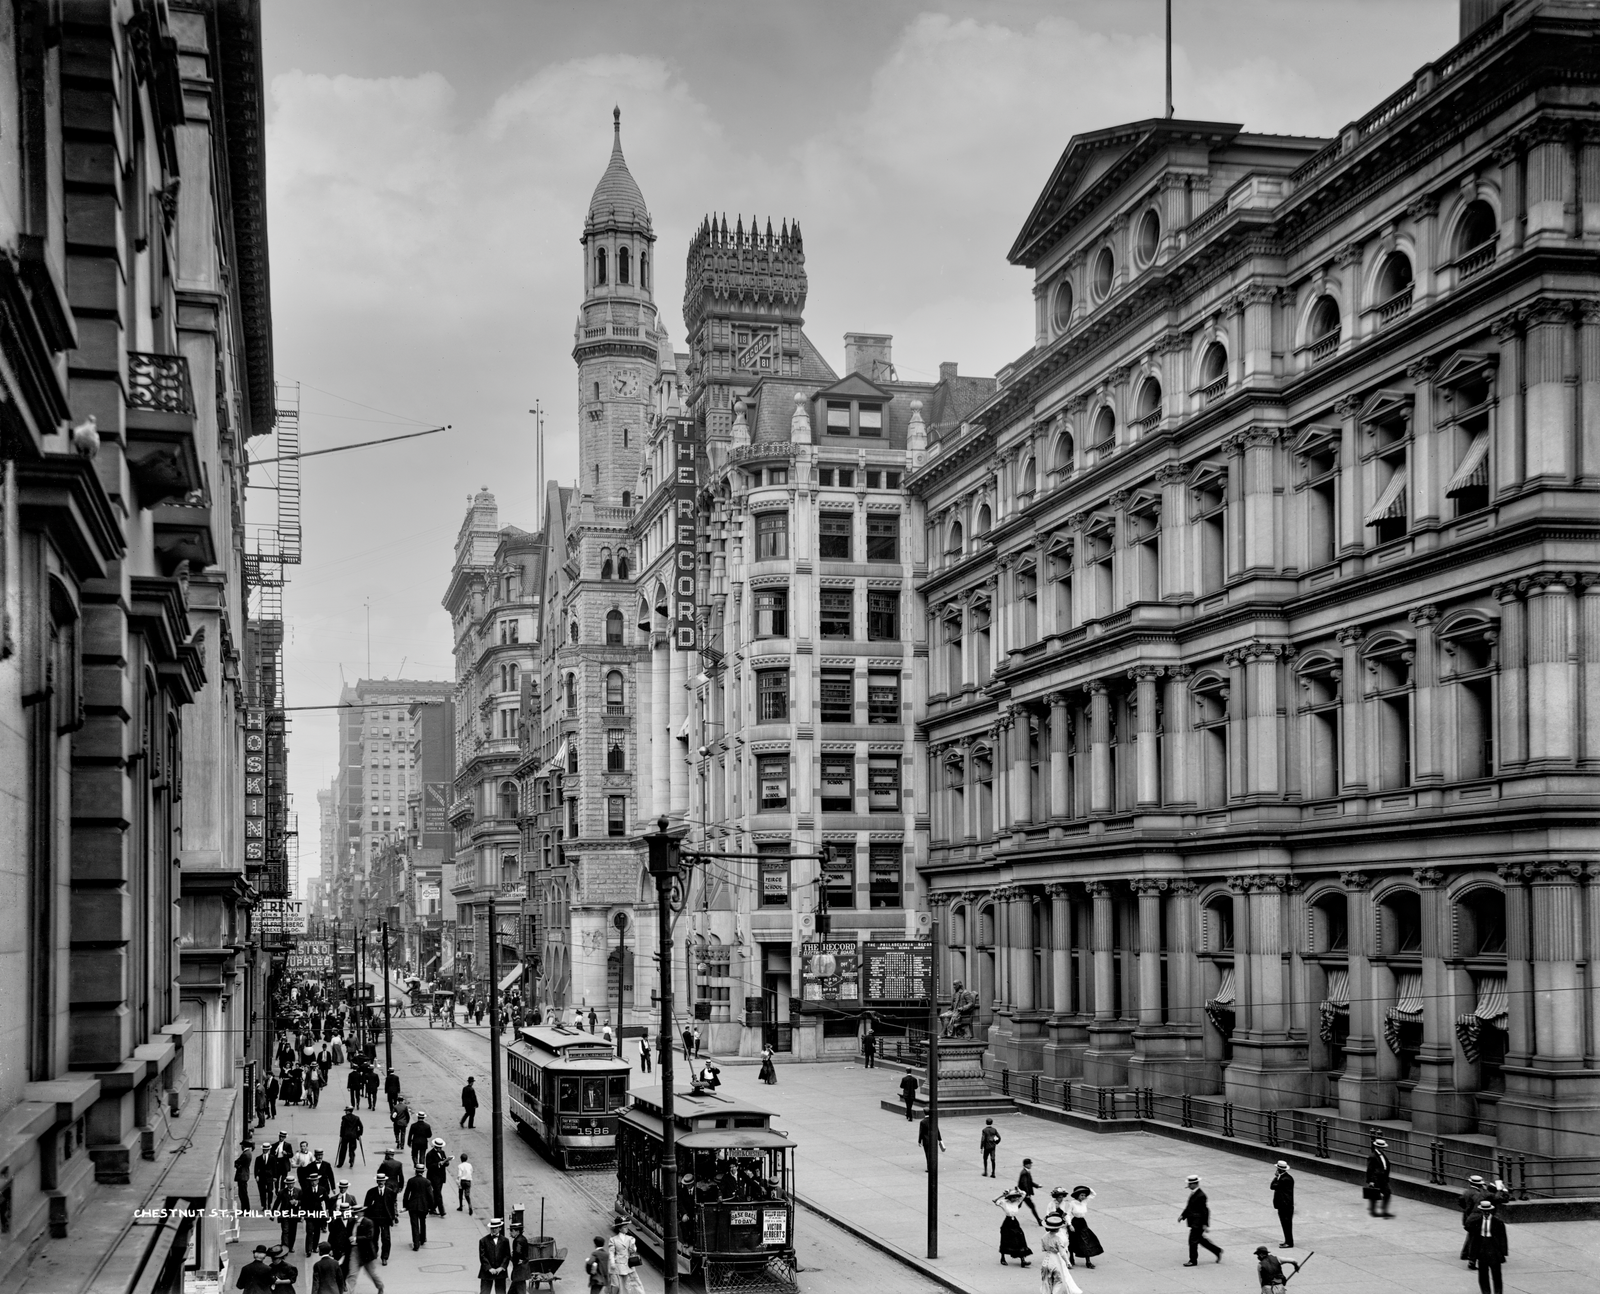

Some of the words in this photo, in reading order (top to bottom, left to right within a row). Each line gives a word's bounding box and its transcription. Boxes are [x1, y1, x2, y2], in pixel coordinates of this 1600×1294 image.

[716, 274, 797, 291] PHILADELPHIA
[739, 335, 747, 344] 18
[740, 335, 768, 368] RECORD
[761, 358, 769, 368] 81
[677, 420, 695, 484] THE
[677, 499, 695, 648] RECORD
[246, 712, 263, 860] HOSKINS
[501, 882, 521, 893] RENT
[270, 902, 302, 912] RENT
[577, 1127, 610, 1135] 1586
[731, 1211, 744, 1220] BASE
[744, 1211, 757, 1220] BALL
